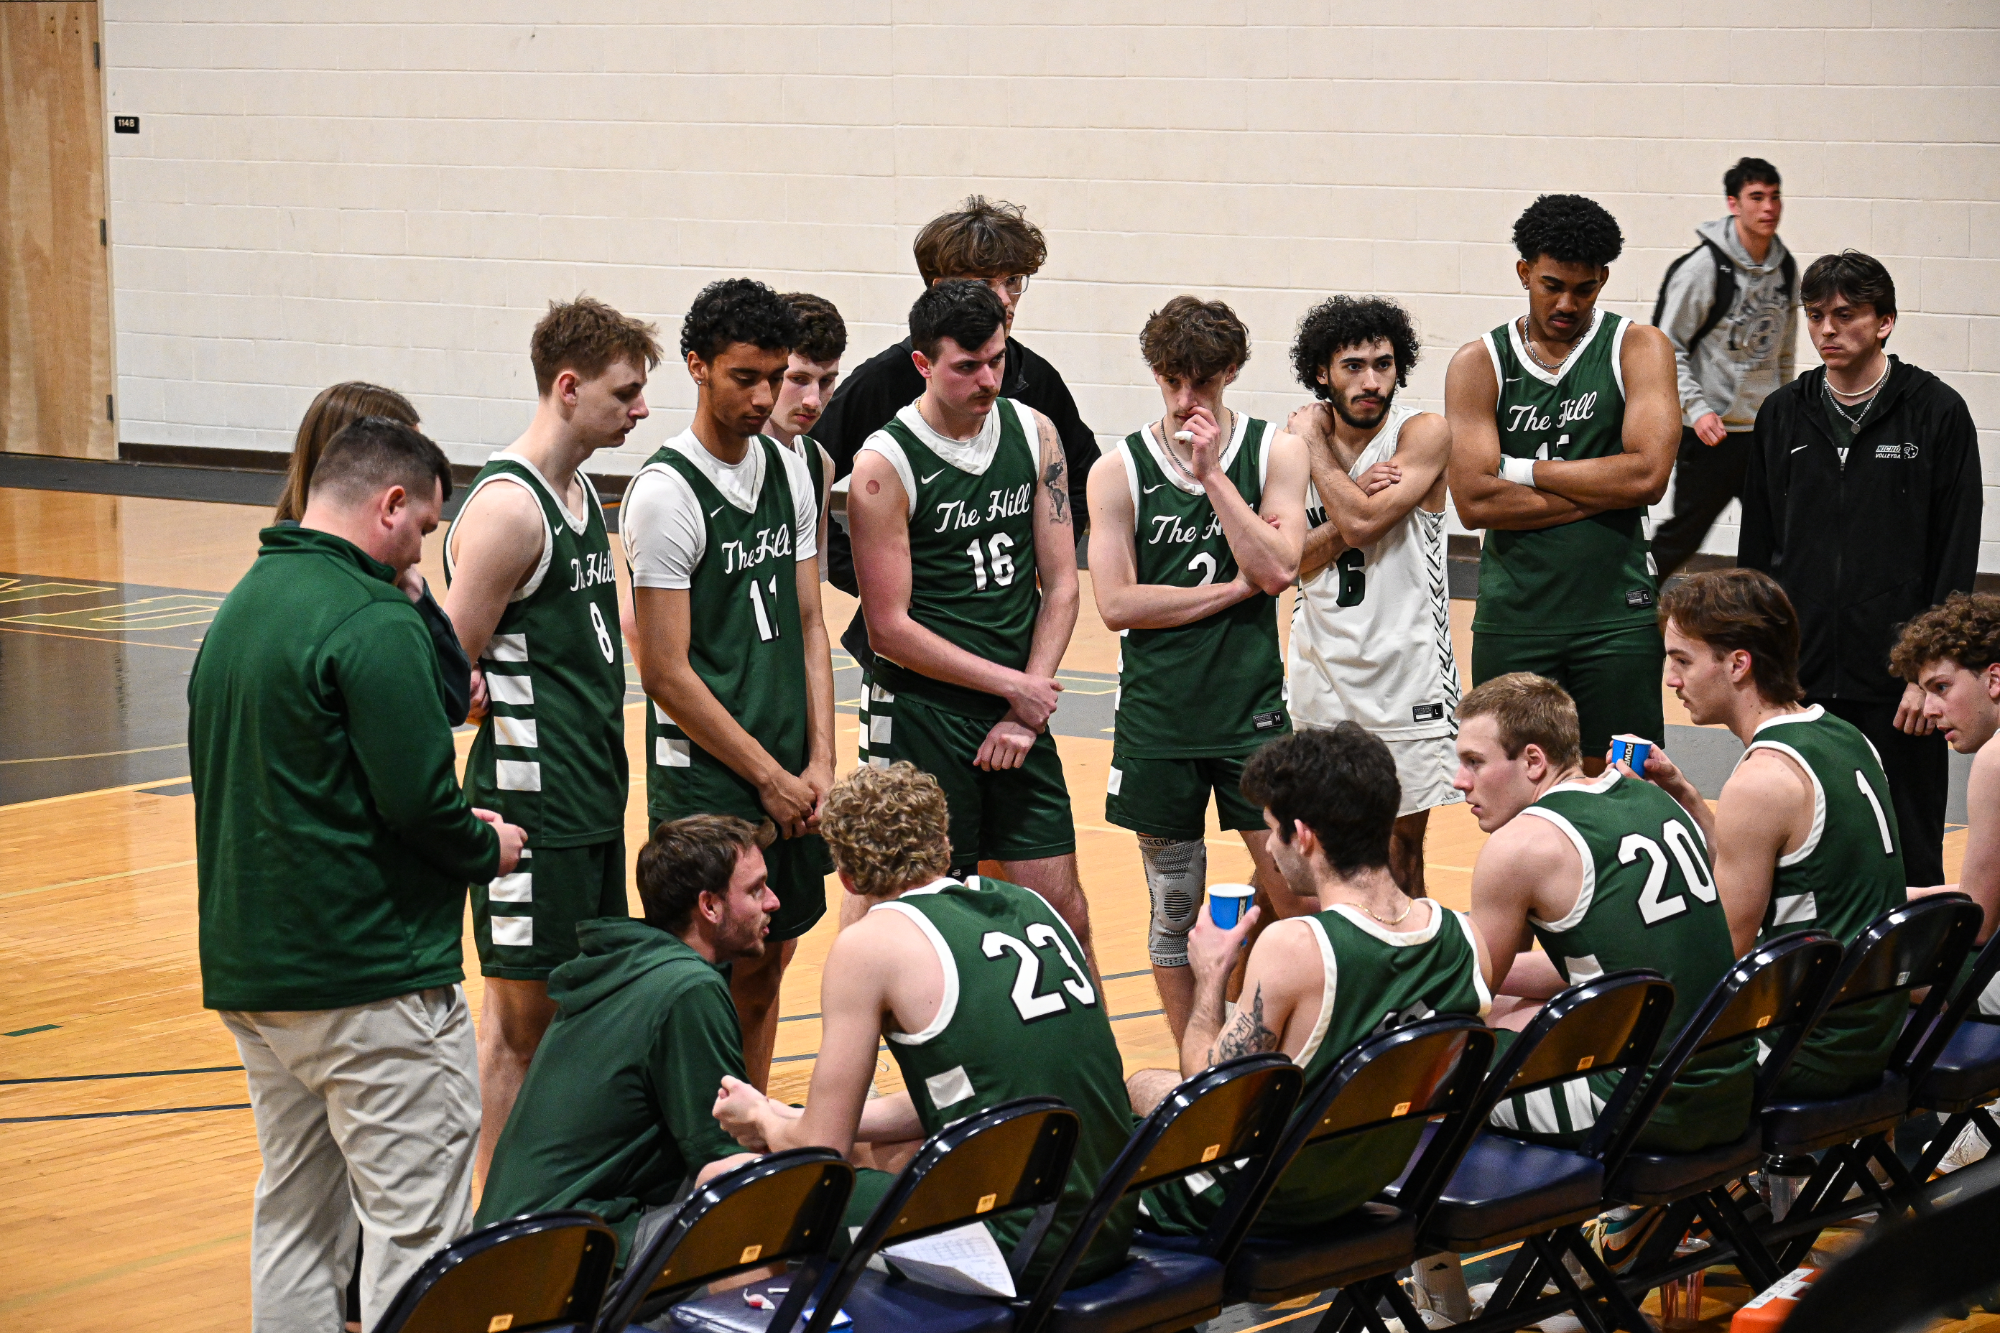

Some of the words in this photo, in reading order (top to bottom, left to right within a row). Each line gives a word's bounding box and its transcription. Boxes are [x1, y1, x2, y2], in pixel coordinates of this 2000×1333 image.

[1507, 404, 1551, 432] The
[934, 499, 981, 533] The
[985, 482, 1031, 522] Hill
[1148, 514, 1197, 545] The
[586, 549, 616, 587] Hill
[721, 539, 755, 575] The
[754, 523, 792, 564] Hill
[966, 531, 1015, 591] 16
[1187, 551, 1217, 588] 2
[1336, 547, 1366, 608] 6
[589, 601, 615, 664] 8
[1854, 769, 1894, 855] 1
[1616, 818, 1719, 927] 20
[981, 922, 1097, 1022] 23
